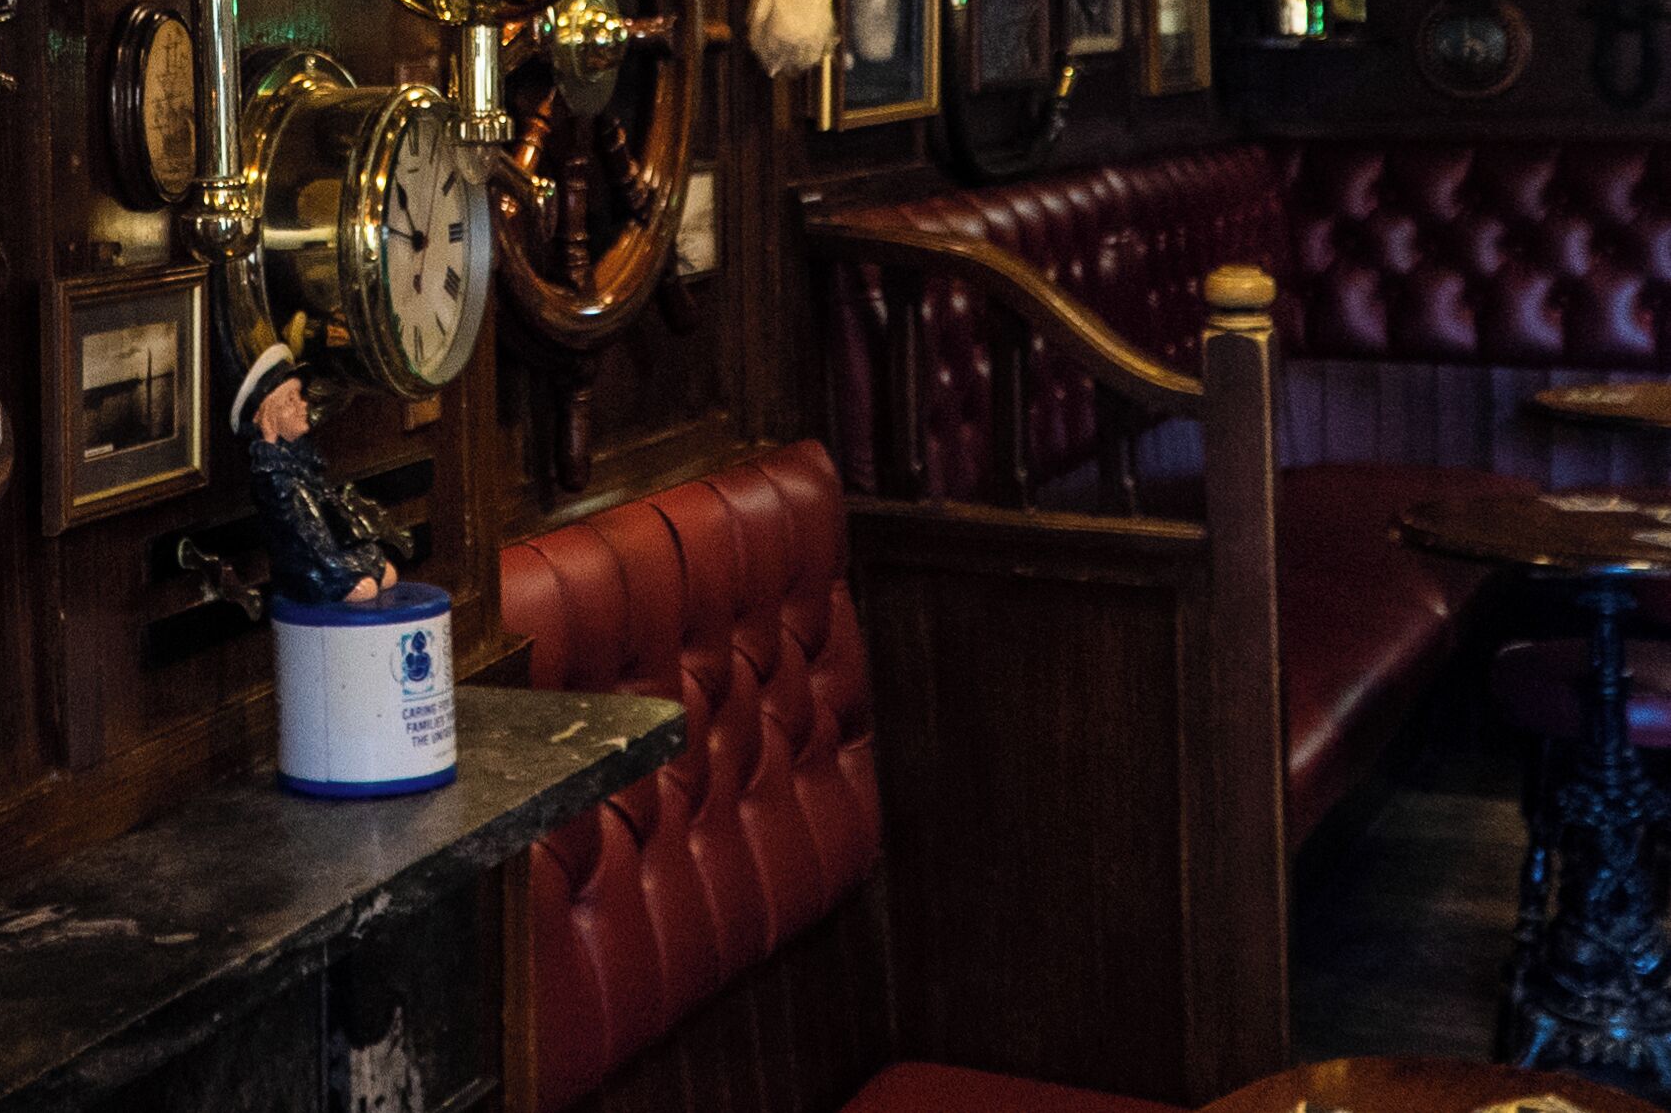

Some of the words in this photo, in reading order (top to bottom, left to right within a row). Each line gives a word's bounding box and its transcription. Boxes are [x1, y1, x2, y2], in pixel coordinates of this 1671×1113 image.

[448, 222, 464, 244] III
[401, 703, 437, 721] CARING
[411, 734, 429, 747] THE
